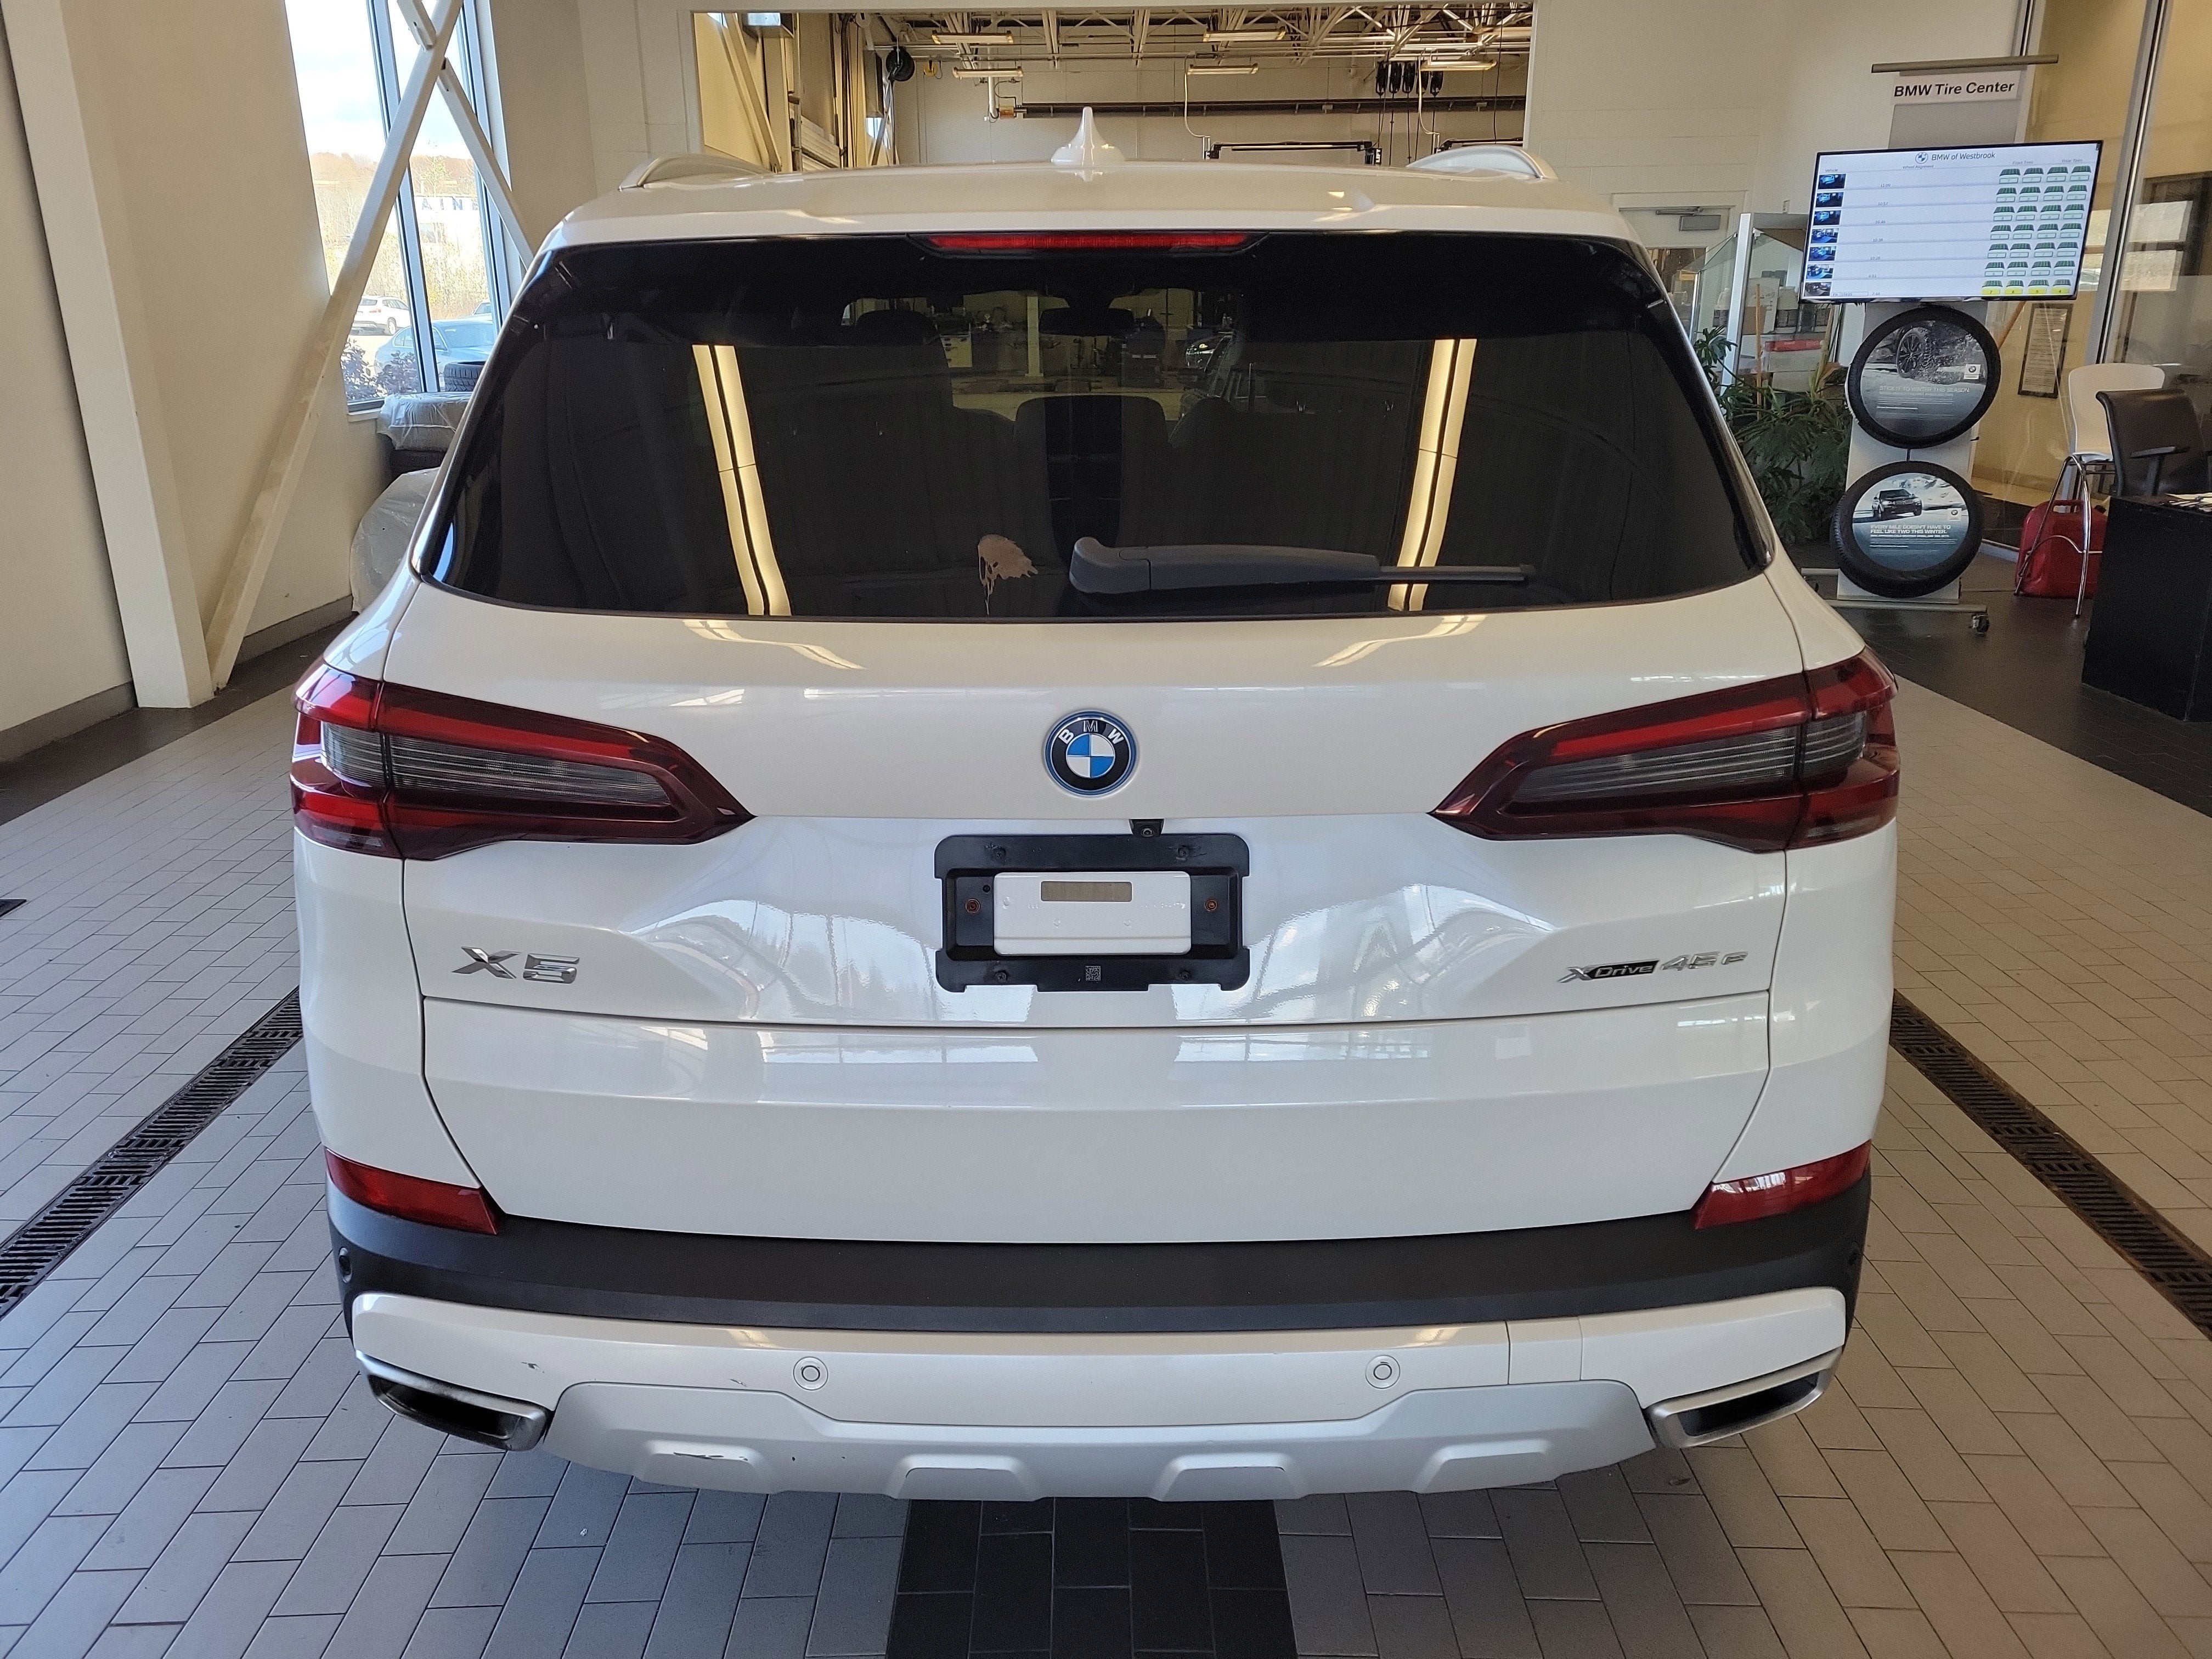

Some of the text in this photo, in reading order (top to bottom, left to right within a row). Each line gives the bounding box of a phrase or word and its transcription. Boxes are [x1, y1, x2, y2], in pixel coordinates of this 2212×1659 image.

[1894, 82, 2015, 97] BMW Tire Center
[1058, 720, 1124, 744] BMW
[451, 946, 580, 984] X5
